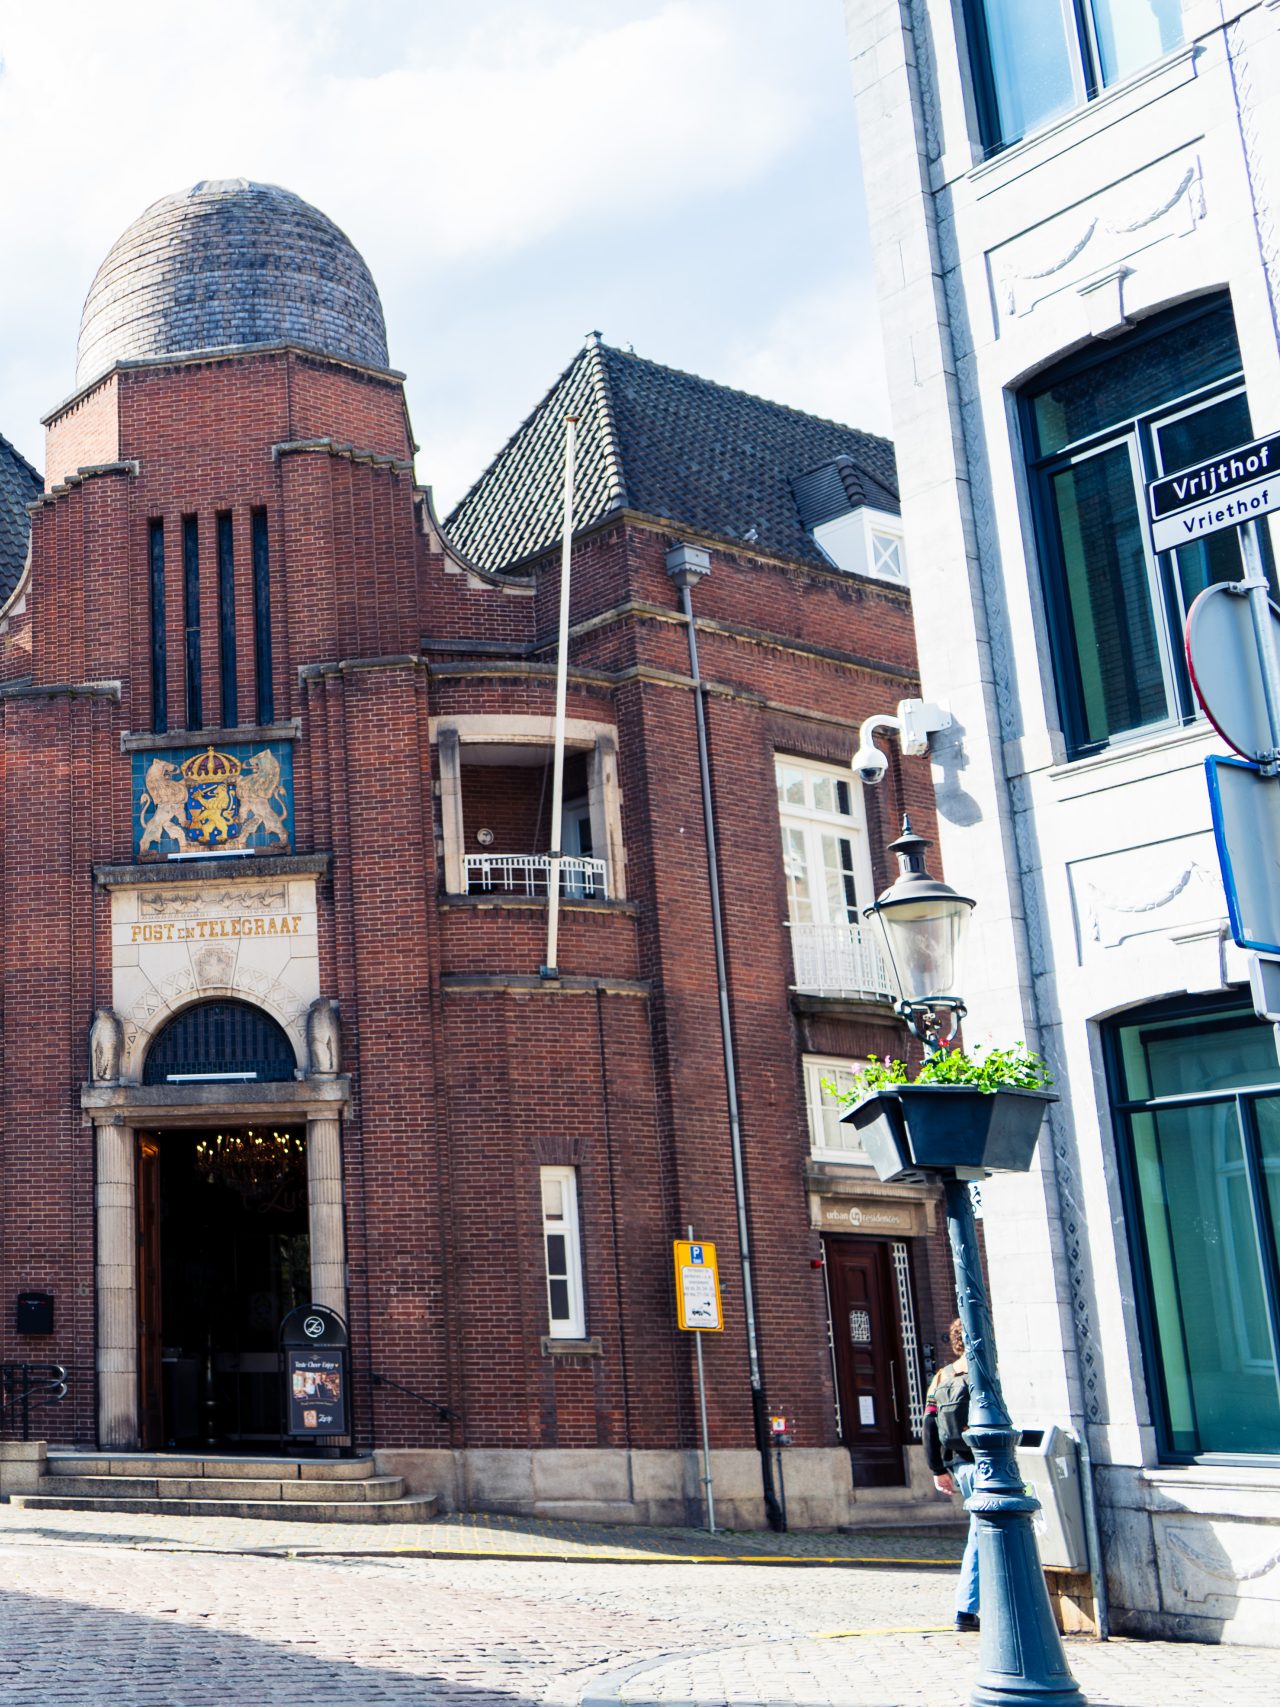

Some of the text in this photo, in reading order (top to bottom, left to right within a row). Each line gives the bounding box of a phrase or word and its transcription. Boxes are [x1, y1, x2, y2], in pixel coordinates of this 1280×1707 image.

[1173, 446, 1268, 499] Vrijthof
[1183, 489, 1268, 533] Vriethof
[131, 916, 302, 943] POST EN TELEGRAAF
[826, 1209, 849, 1220] urban
[861, 1212, 900, 1224] residences
[693, 1246, 700, 1258] P
